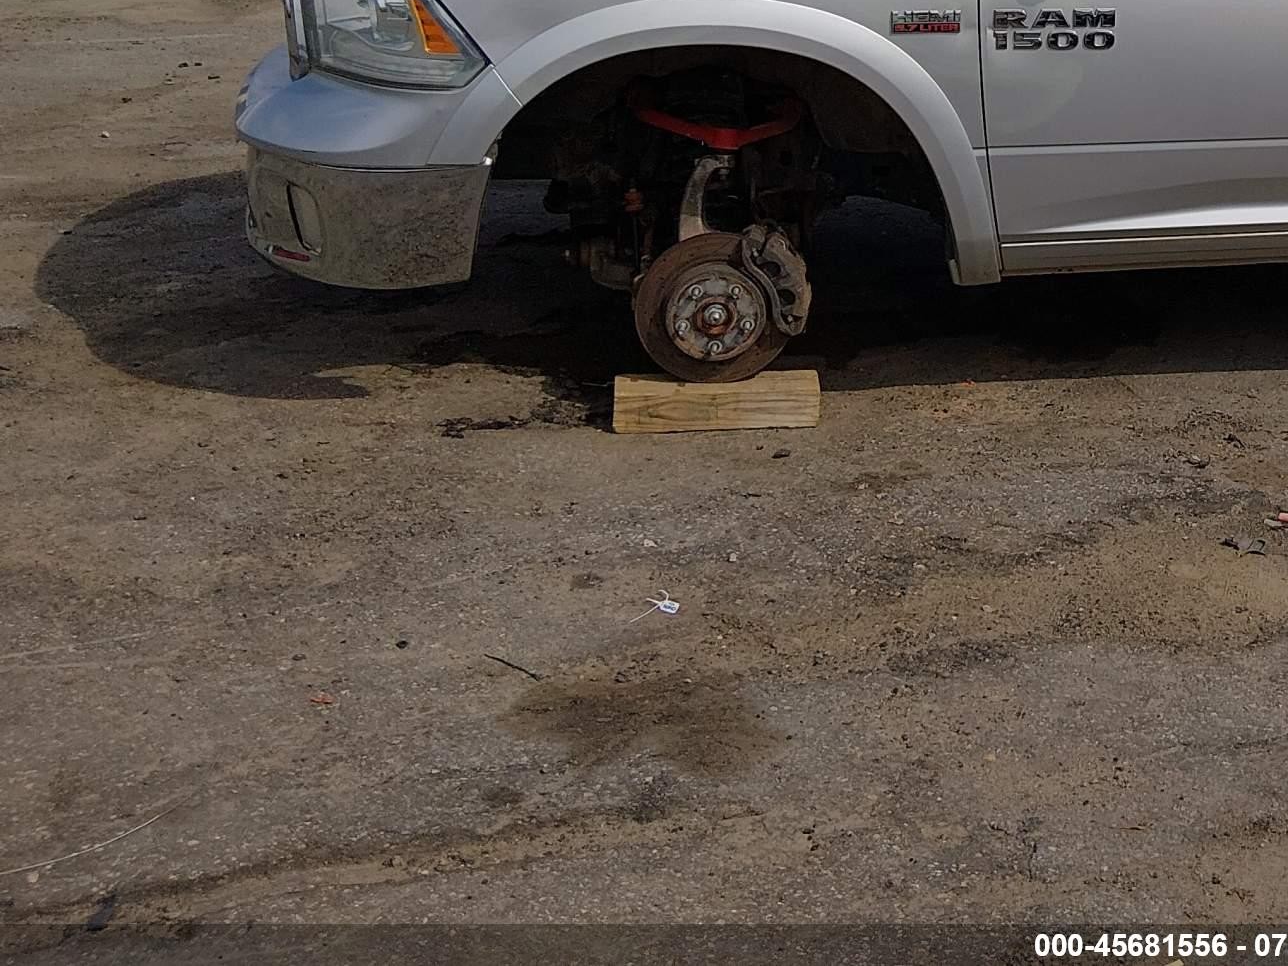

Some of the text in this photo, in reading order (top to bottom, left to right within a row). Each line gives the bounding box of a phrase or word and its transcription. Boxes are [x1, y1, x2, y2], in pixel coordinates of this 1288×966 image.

[891, 10, 961, 22] HEMI
[992, 8, 1116, 28] RAM
[919, 22, 960, 32] LITER
[992, 29, 1116, 50] 1500
